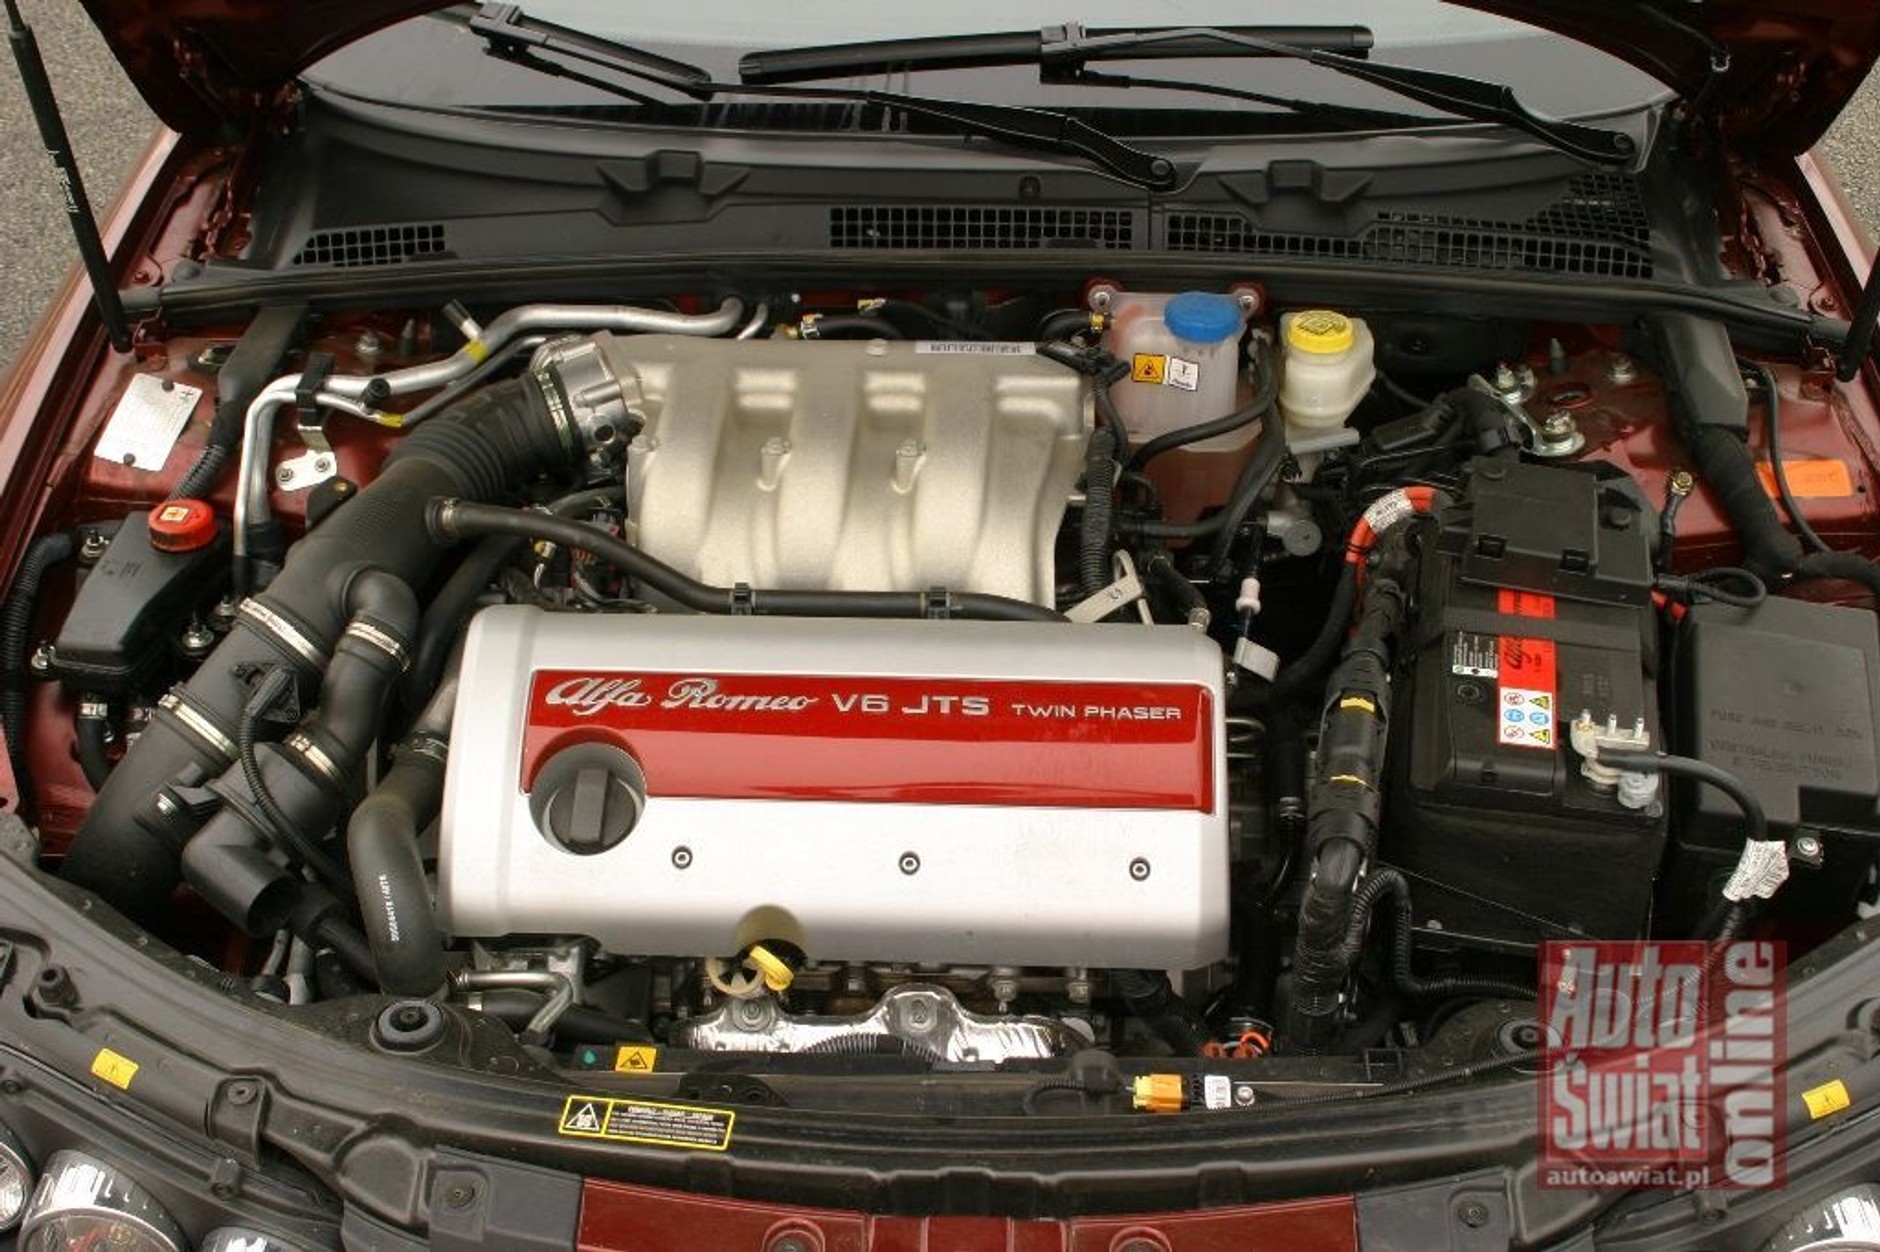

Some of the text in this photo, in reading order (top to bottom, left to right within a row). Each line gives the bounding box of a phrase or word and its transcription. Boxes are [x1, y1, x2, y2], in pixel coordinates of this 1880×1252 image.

[545, 677, 1182, 720] Alfa Romeo V6 JTS TWIN PHASER
